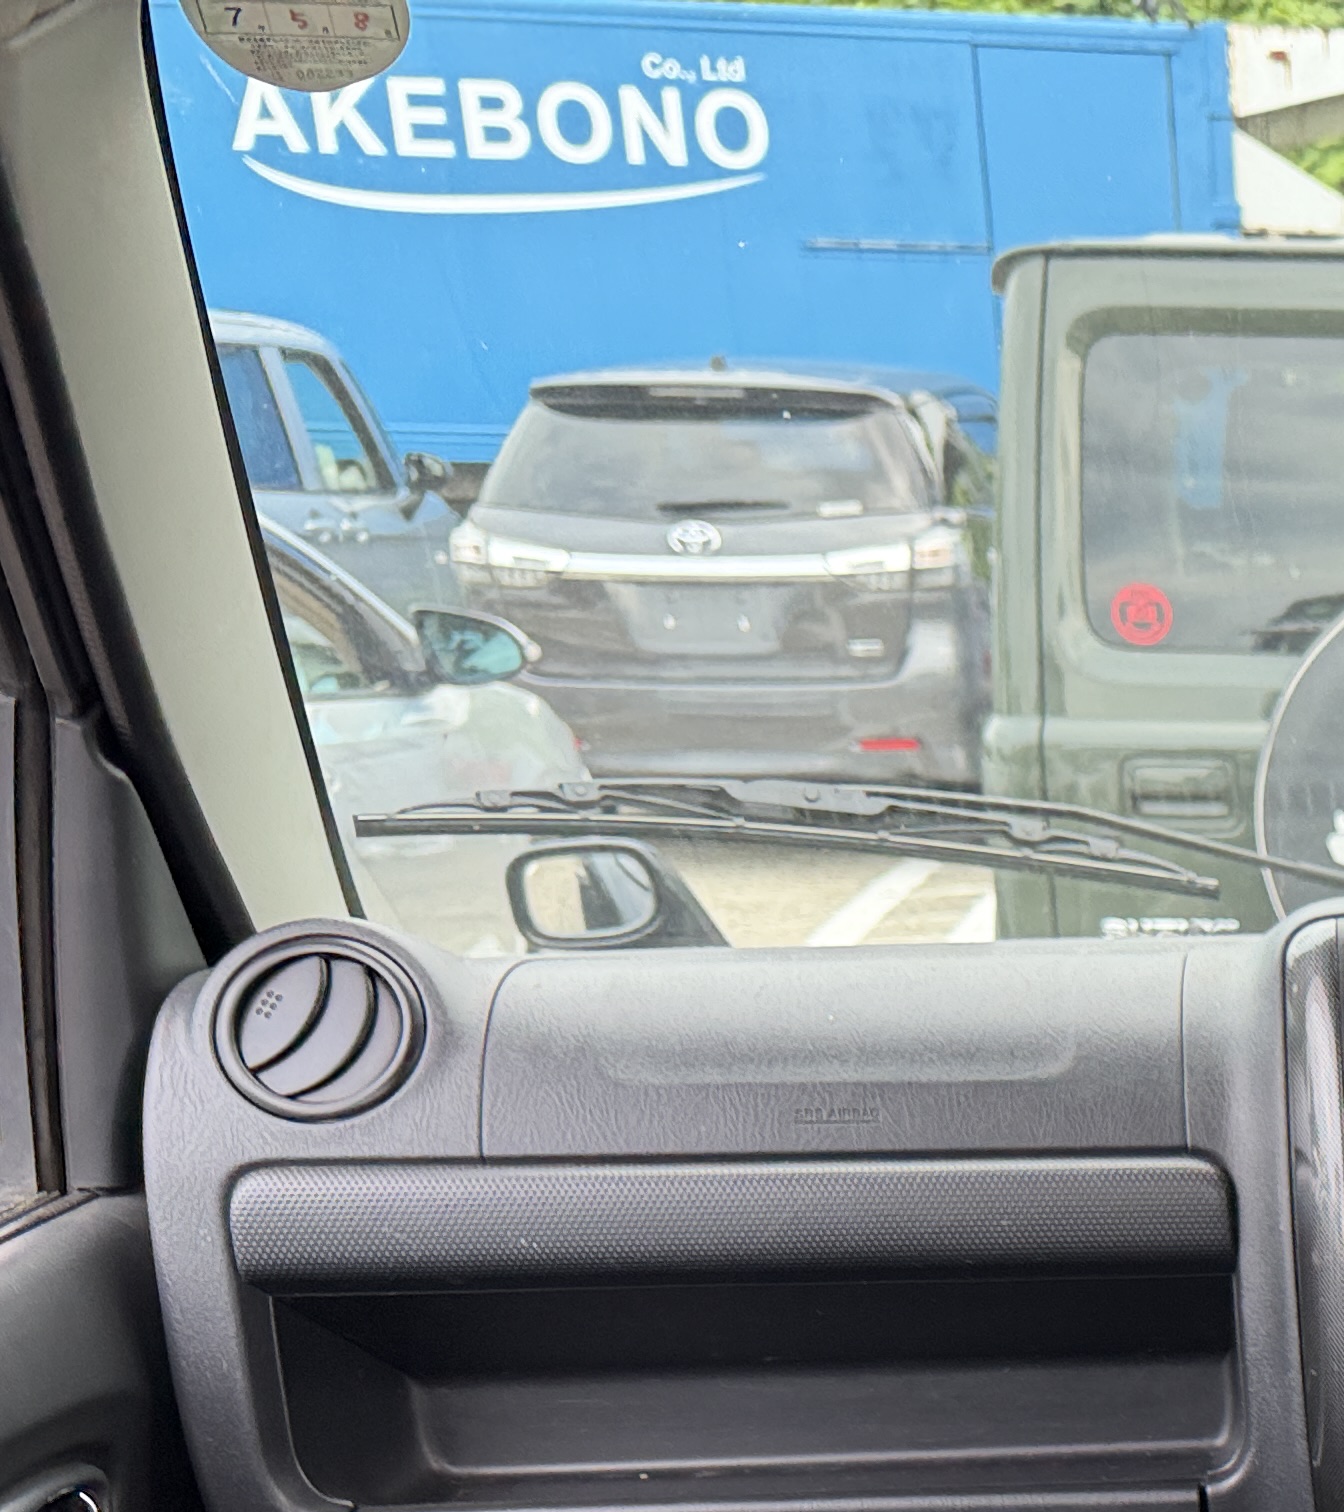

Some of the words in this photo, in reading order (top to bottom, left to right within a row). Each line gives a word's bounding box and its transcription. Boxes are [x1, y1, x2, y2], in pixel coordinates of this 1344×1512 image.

[224, 7, 242, 27] 7
[289, 9, 309, 30] 5
[353, 11, 370, 32] 8
[700, 54, 746, 82] Ltd
[232, 76, 770, 170] AKEBONO
